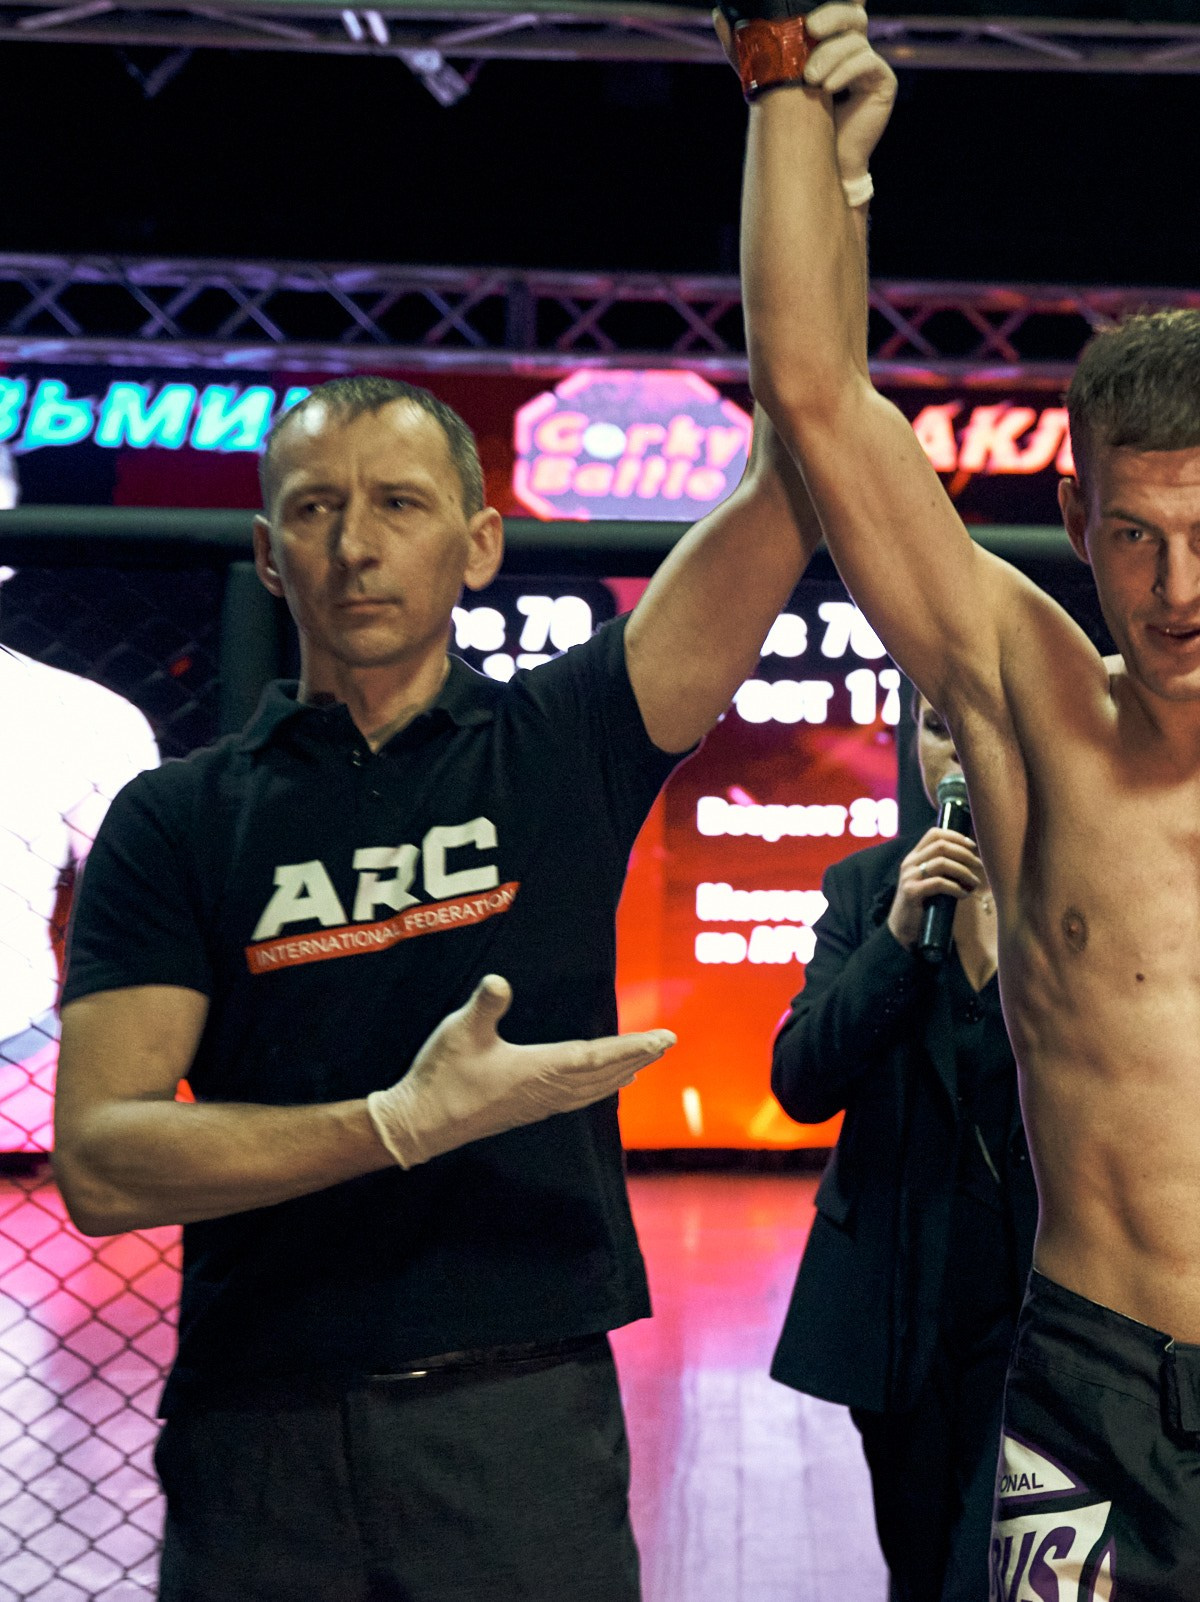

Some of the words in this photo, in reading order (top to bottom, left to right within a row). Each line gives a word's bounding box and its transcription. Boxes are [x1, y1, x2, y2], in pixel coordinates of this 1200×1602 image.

[0, 376, 300, 453] ЬМИ
[251, 816, 500, 941] ARC
[257, 921, 402, 966] INTERNATIONAL
[403, 888, 517, 932] FEDERATION
